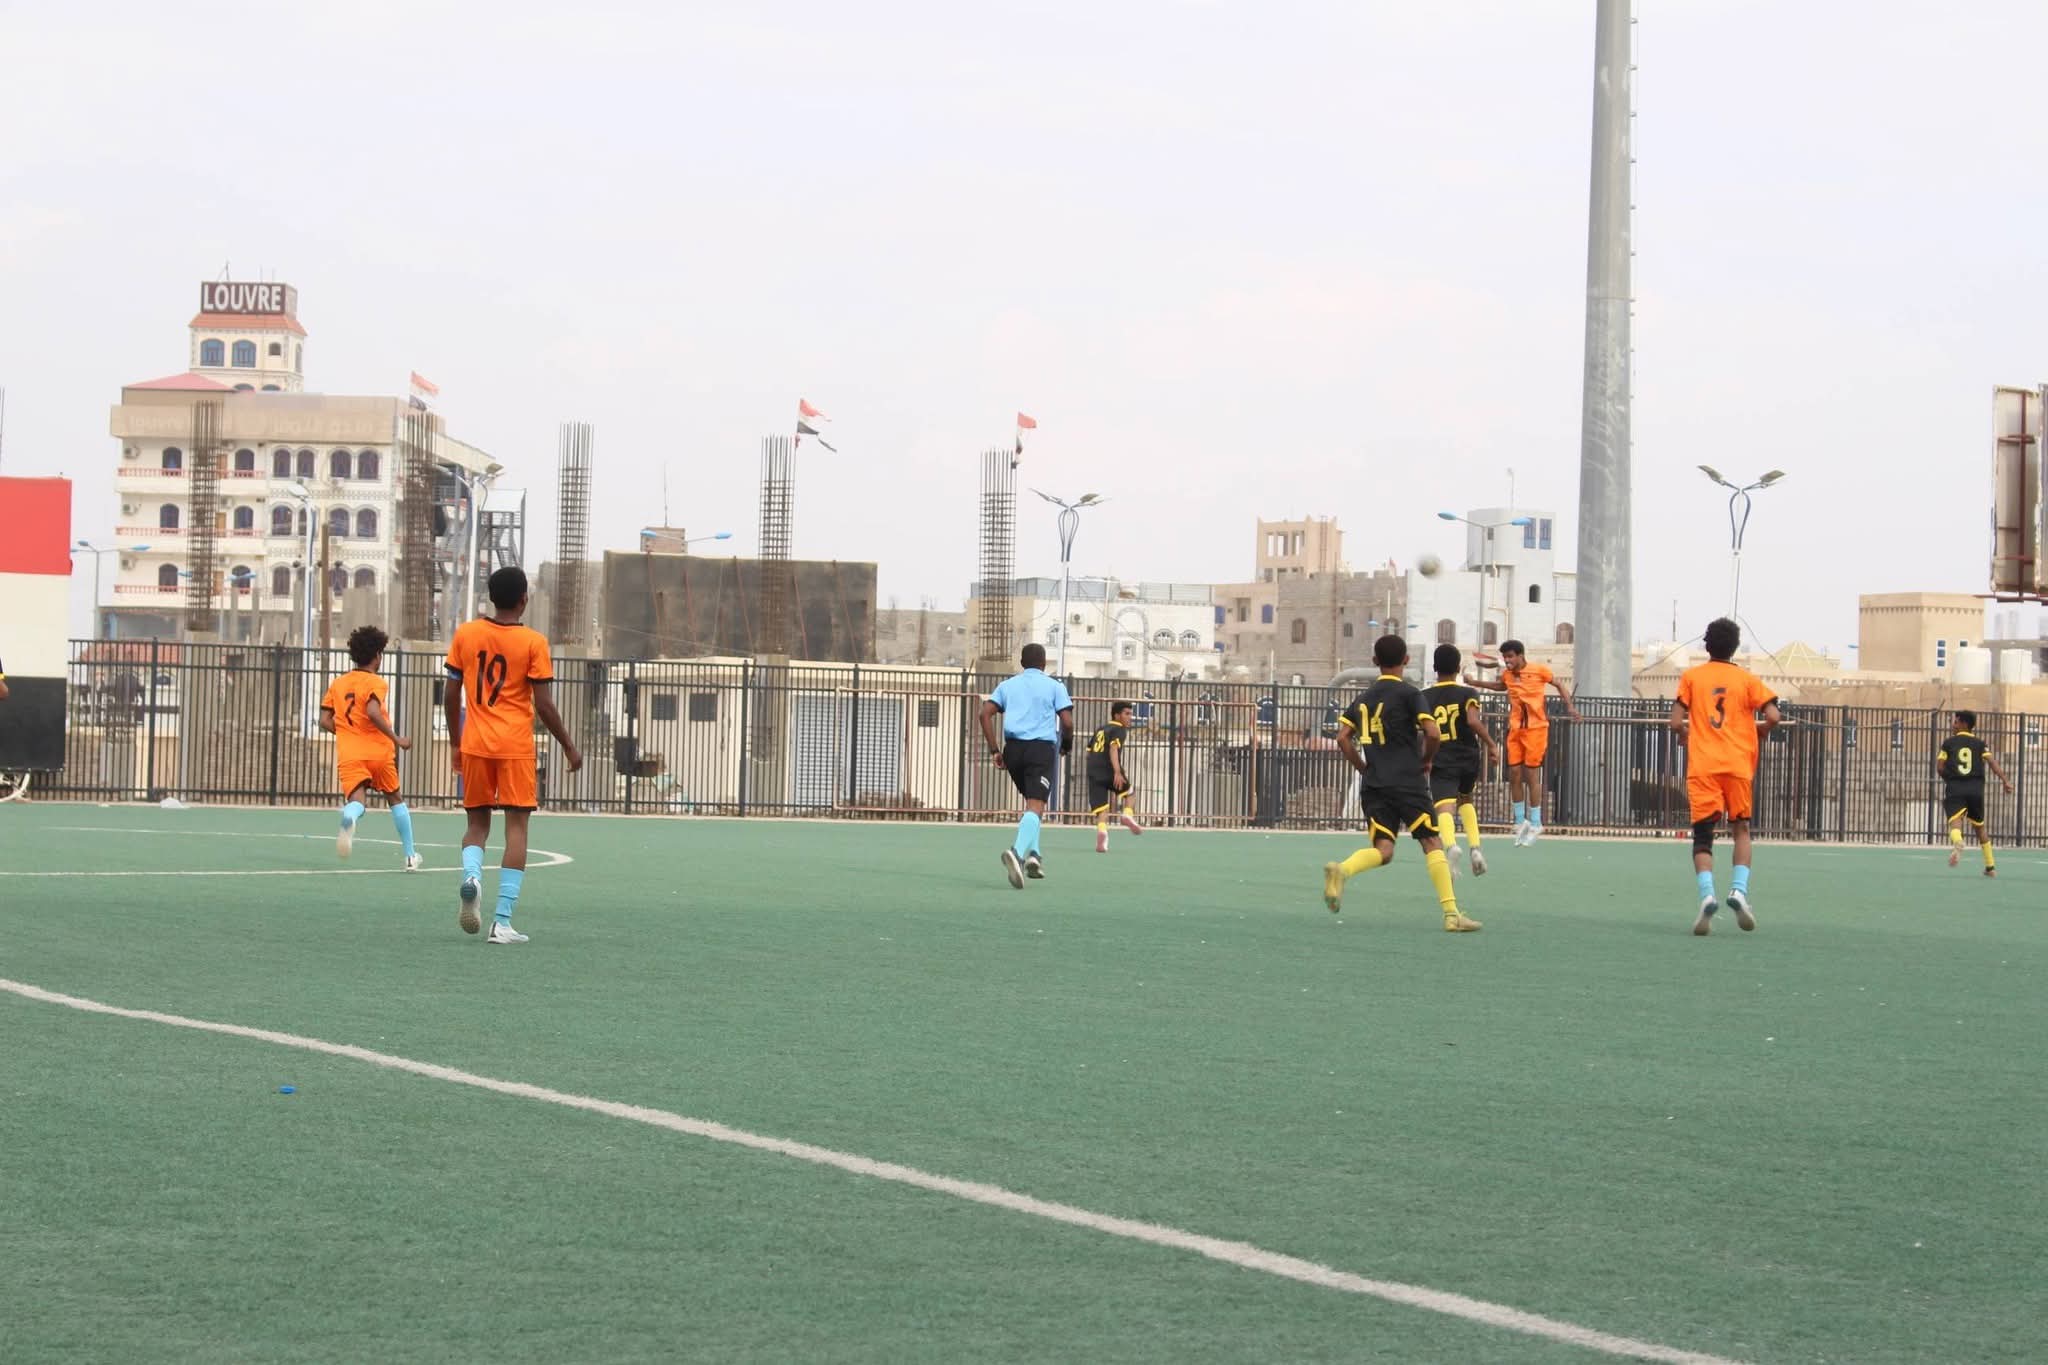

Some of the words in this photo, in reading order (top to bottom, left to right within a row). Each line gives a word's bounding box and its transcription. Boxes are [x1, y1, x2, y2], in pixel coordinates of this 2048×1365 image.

[203, 284, 282, 311] LOUVRE
[475, 650, 507, 707] 19
[1359, 702, 1386, 745] 14
[1433, 703, 1460, 742] 27
[1710, 687, 1727, 729] 3
[1957, 747, 1972, 775] 9
